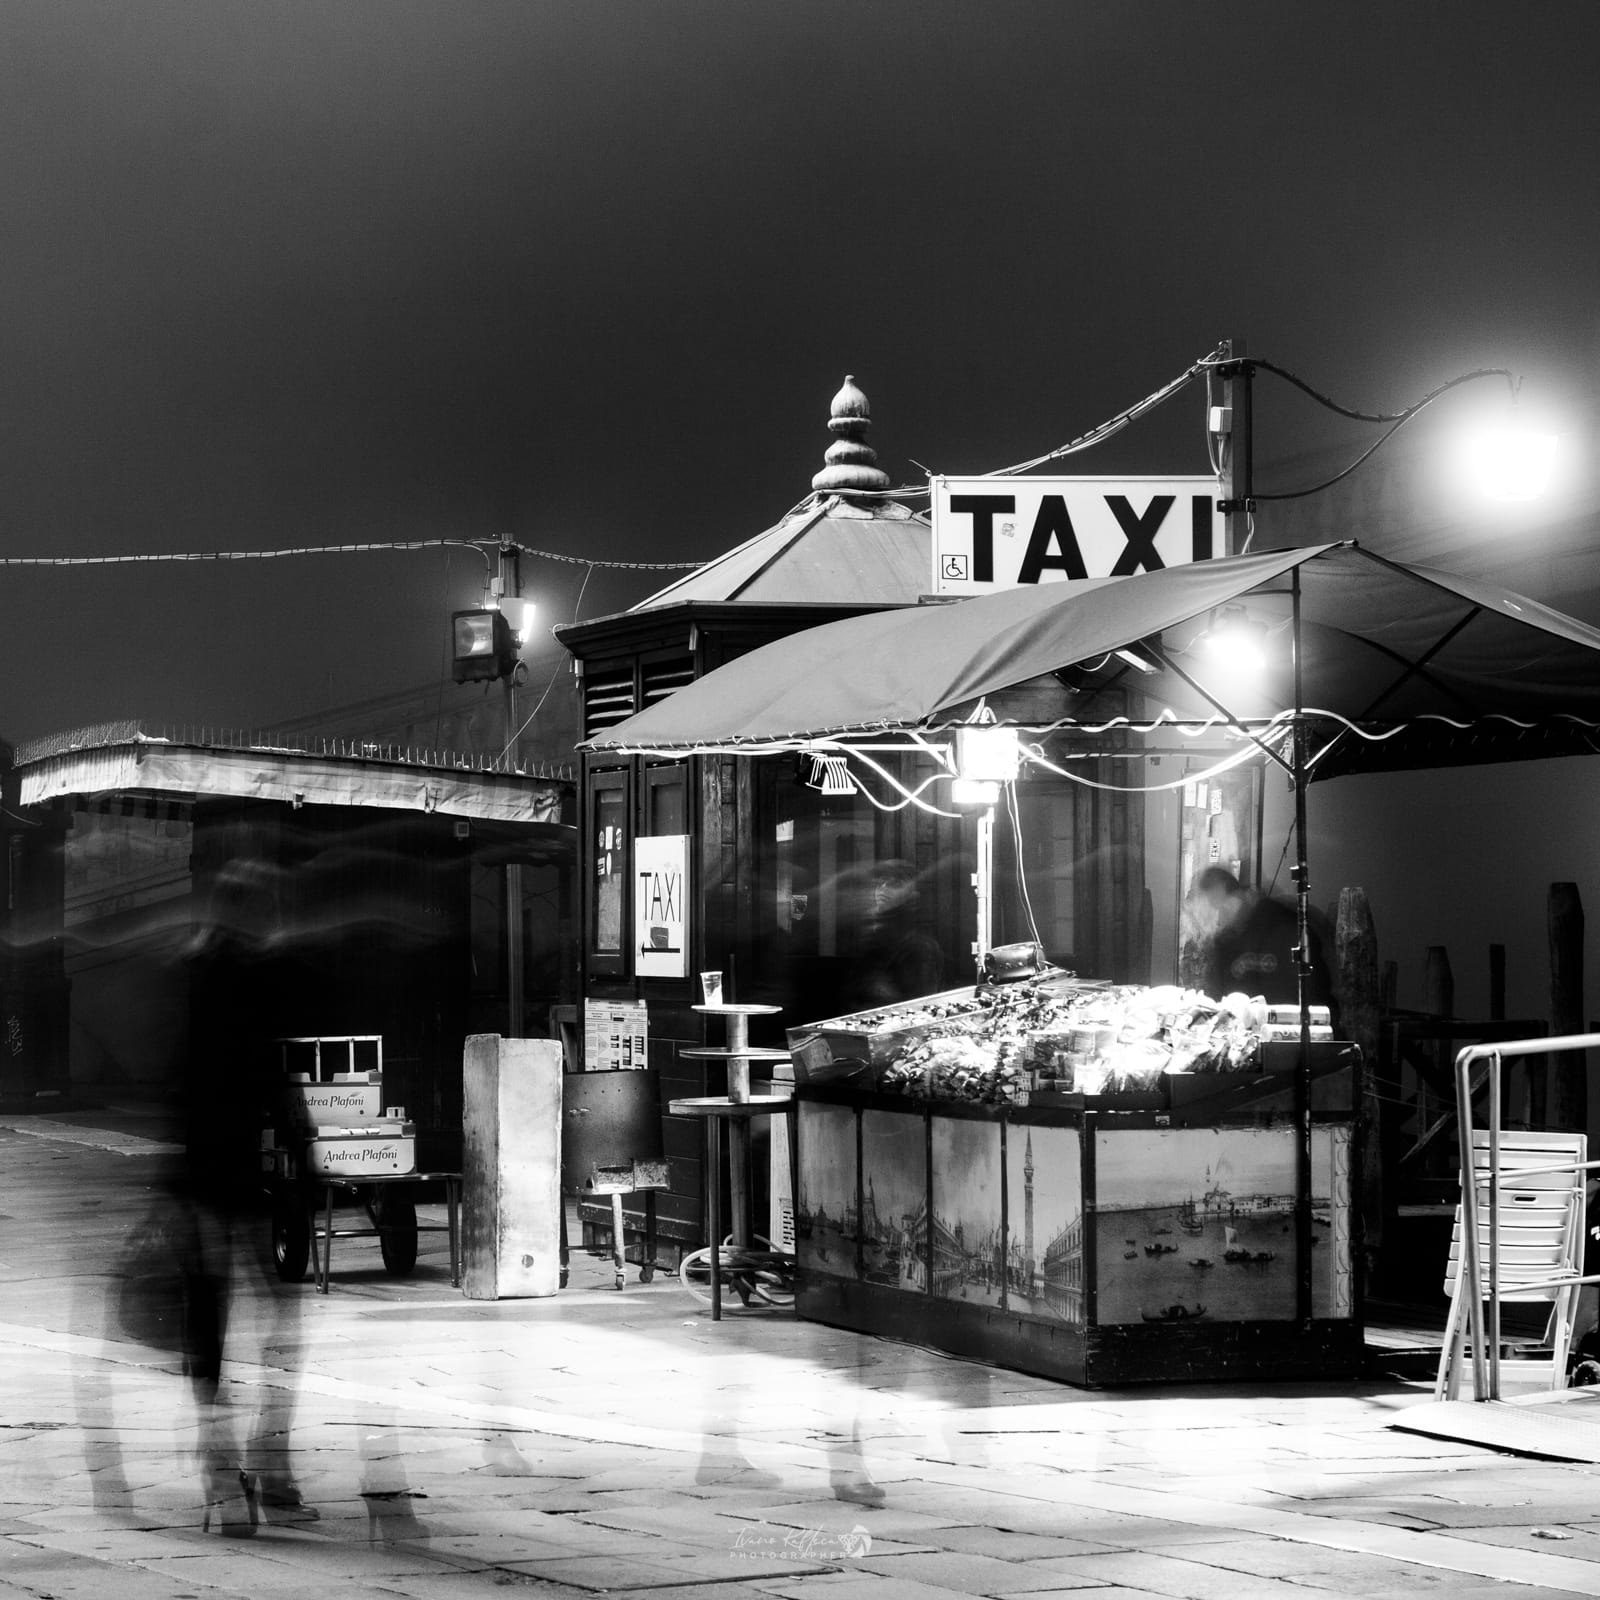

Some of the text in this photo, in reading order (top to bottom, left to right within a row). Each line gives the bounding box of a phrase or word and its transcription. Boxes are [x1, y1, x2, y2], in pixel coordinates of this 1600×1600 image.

[950, 495, 1213, 584] TAXI
[640, 872, 682, 923] TAXI
[295, 1096, 364, 1108] Andrea Plafoni
[323, 1149, 397, 1162] Andrea Plafoni
